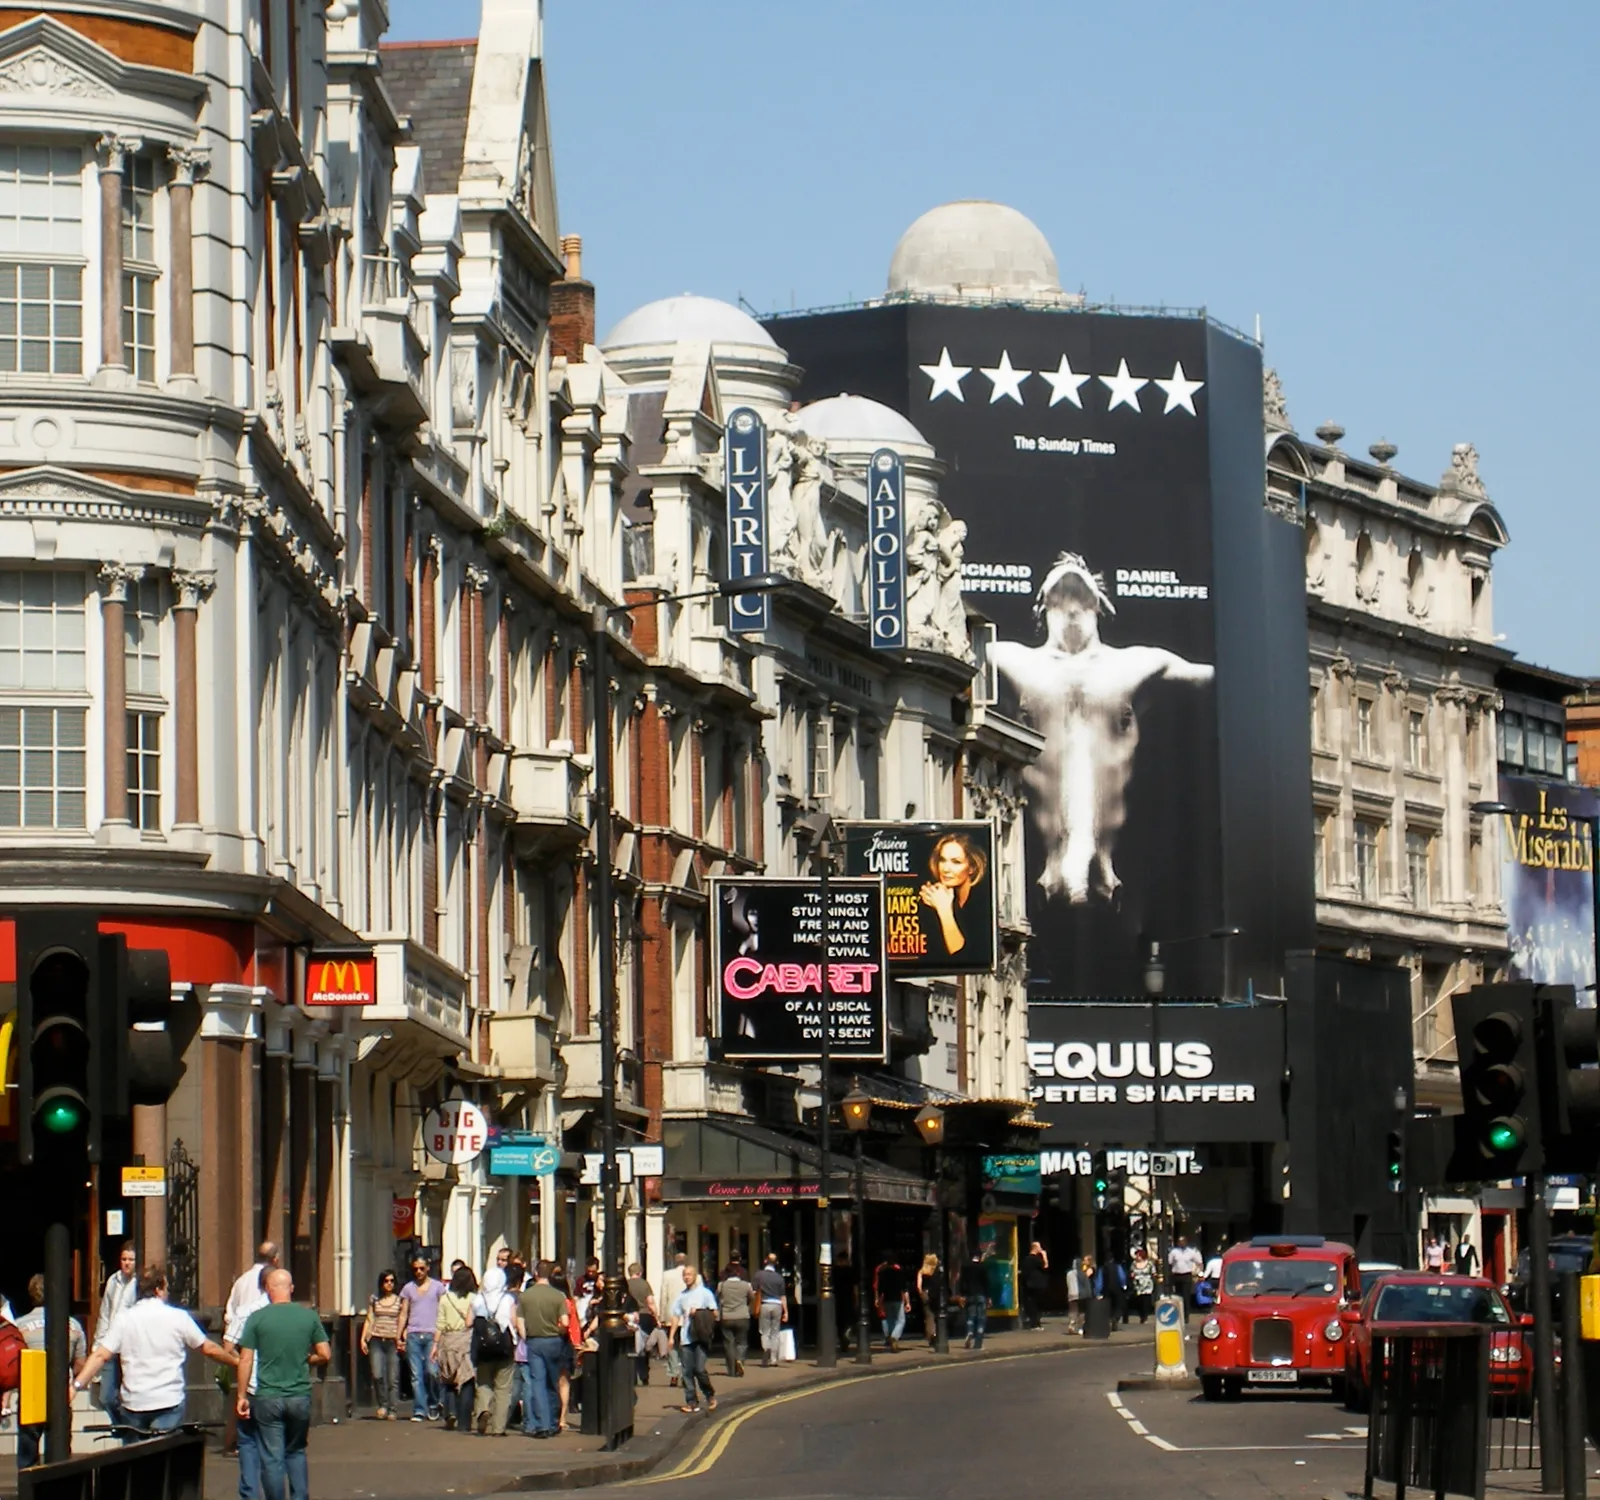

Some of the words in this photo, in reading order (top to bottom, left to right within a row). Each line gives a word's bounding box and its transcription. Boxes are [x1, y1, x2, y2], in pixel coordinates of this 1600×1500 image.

[1013, 435, 1036, 450] The
[1038, 436, 1080, 455] Sunday
[1081, 438, 1116, 455] Times
[731, 447, 762, 617] LYRIC
[873, 478, 900, 639] APOLLO
[960, 563, 1032, 578] ICHARD
[1116, 569, 1180, 584] DANIEL
[1116, 584, 1208, 599] RADCLIFFE
[1540, 790, 1567, 831] Les
[864, 830, 907, 857] Jessica
[1503, 813, 1593, 872] Misérabl
[868, 852, 909, 872] LANGE
[835, 893, 869, 904] MOST
[887, 895, 920, 914] IAMS'
[843, 921, 869, 931] AND
[889, 915, 920, 935] LASS
[793, 933, 869, 944] IMAGNATIVE
[828, 947, 870, 957] EVIVAL
[724, 957, 879, 999] CABARET
[312, 992, 370, 1002] McDonald's
[785, 1002, 801, 1012] OF
[805, 1002, 815, 1012] A
[797, 1015, 822, 1025] THA
[830, 1015, 835, 1024] I
[838, 1015, 871, 1025] HAVE
[1027, 1042, 1214, 1082] EQUUS
[1029, 1085, 1117, 1103] PETER
[1126, 1085, 1256, 1103] SHAFFER
[440, 1111, 474, 1129] BIG
[434, 1134, 481, 1152] BITE
[709, 1183, 740, 1195] Come
[743, 1185, 754, 1195] to
[757, 1181, 774, 1195] the
